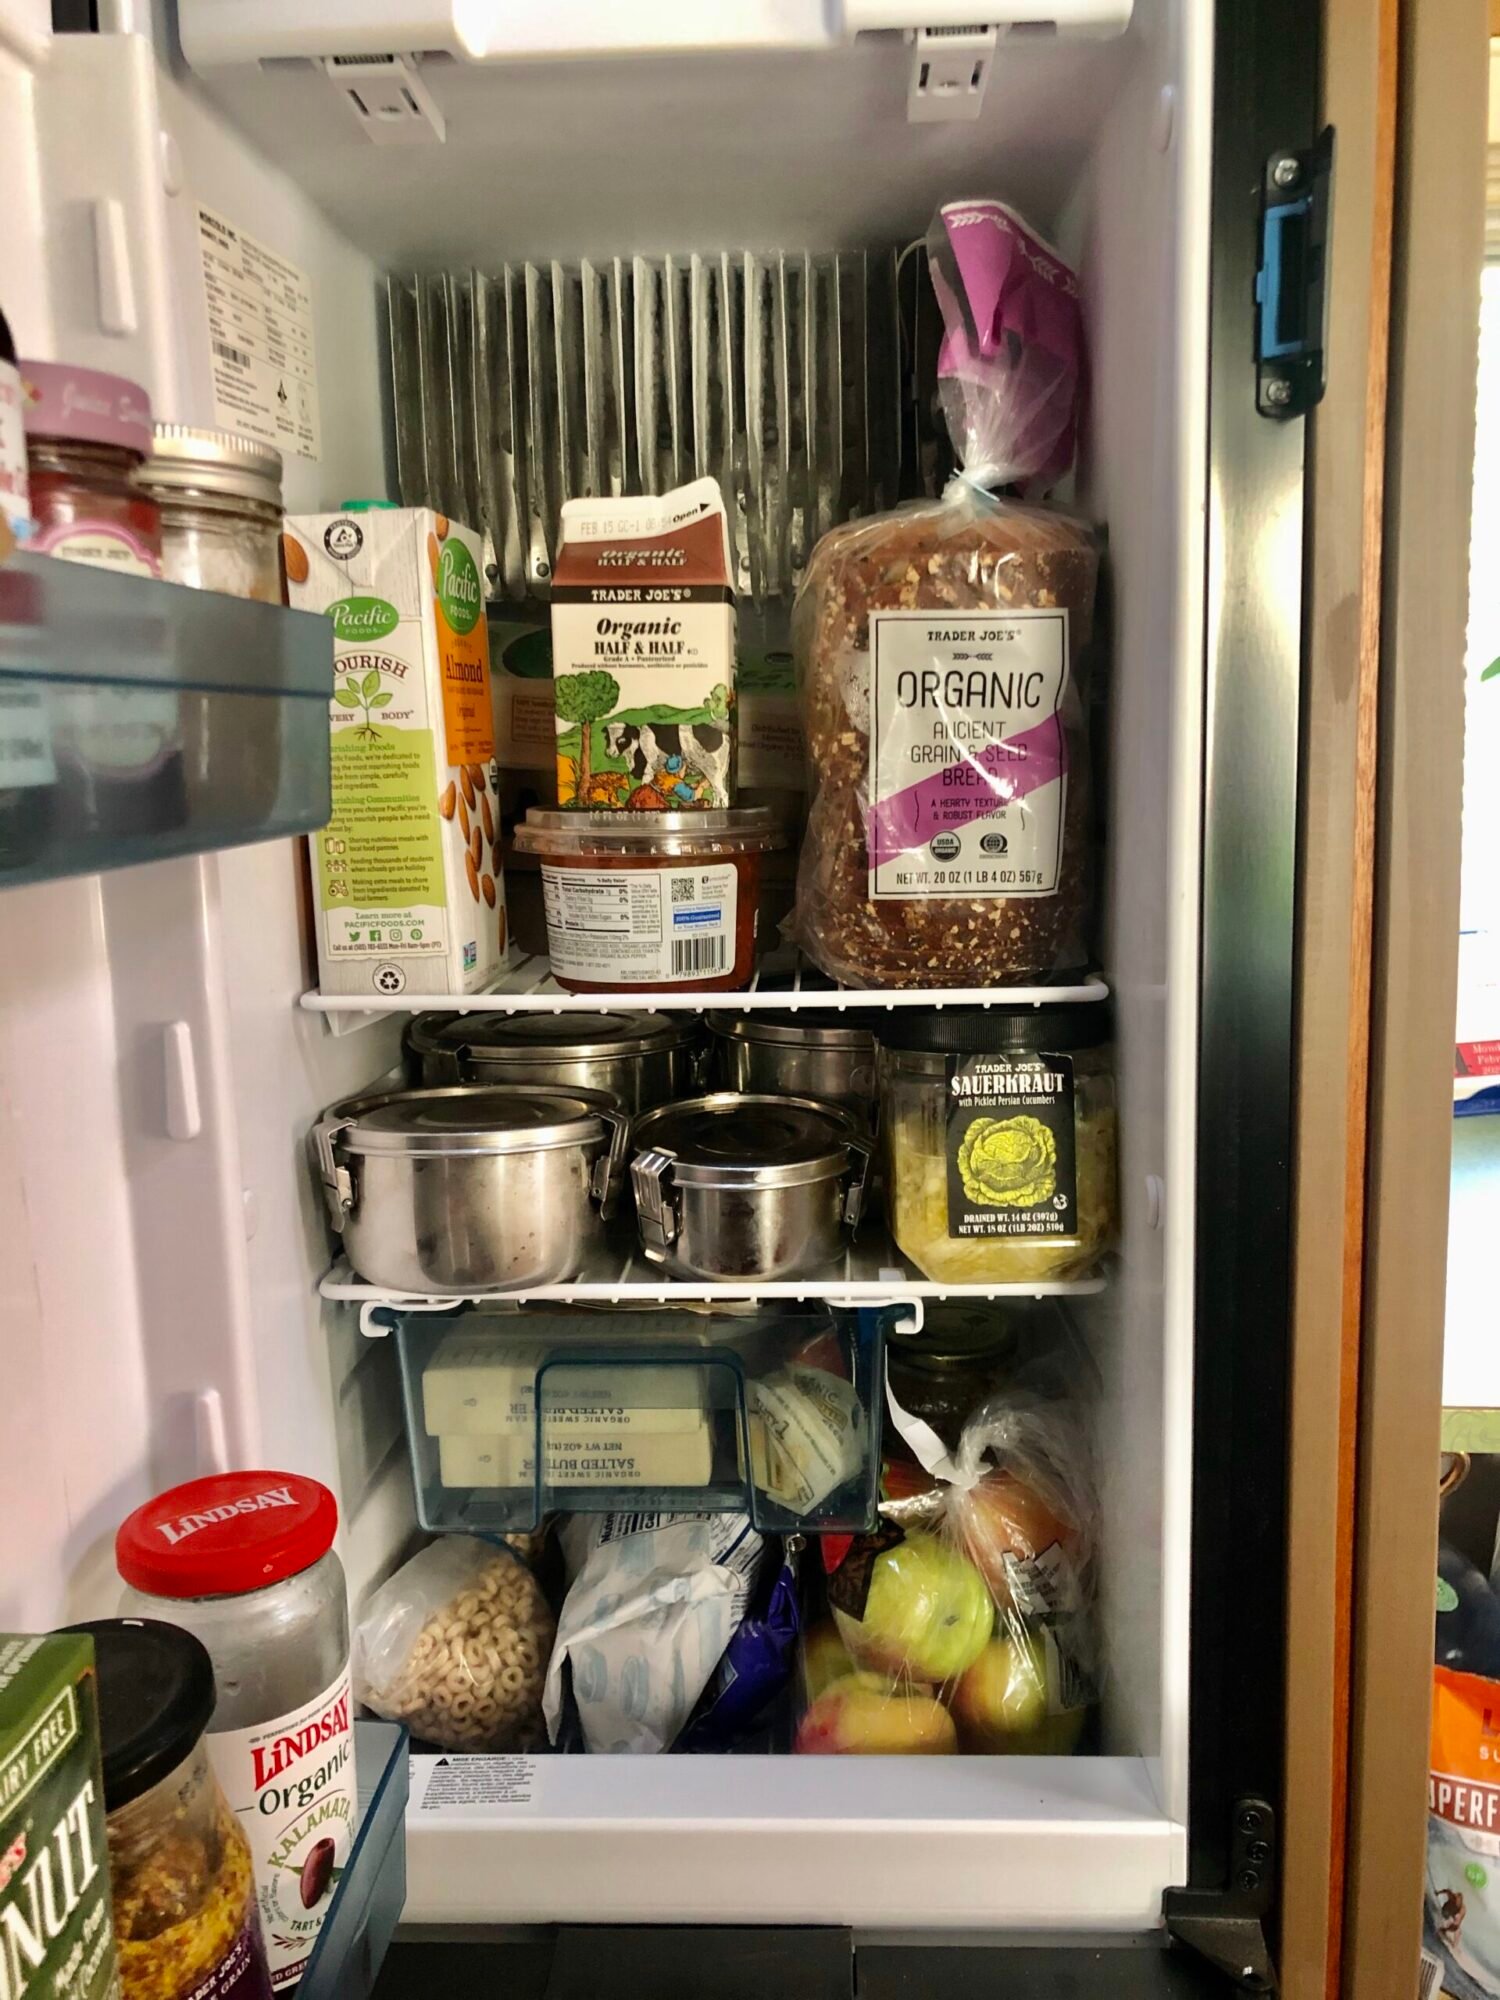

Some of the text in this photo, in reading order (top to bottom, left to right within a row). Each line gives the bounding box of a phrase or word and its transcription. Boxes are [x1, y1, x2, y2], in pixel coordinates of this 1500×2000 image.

[672, 508, 698, 523] Open
[581, 521, 597, 535] FEB
[603, 519, 613, 534] 15
[602, 548, 685, 561] Organic
[597, 558, 630, 566] HALF
[652, 558, 687, 566] HALF
[442, 549, 478, 604] Pacific
[591, 589, 641, 601] TRADER
[330, 604, 391, 628] Pacific
[596, 617, 682, 640] Organic
[927, 630, 976, 642] TRADER
[594, 641, 685, 655] HALF & HALF
[333, 655, 409, 679] OURISH
[446, 653, 484, 683] Almond
[897, 670, 1044, 709] ORGANIC
[328, 714, 355, 722] VERY
[933, 721, 1006, 740] ANCIENT
[911, 745, 962, 763] GRAIN
[985, 743, 1028, 762] SEED
[930, 799, 937, 807] A
[940, 799, 971, 808] HEARTY
[942, 810, 973, 820] ROBUST
[976, 809, 1007, 820] FLAVOR
[896, 873, 914, 884] NET
[934, 871, 946, 884] 20
[948, 871, 961, 884] OZ
[963, 870, 972, 885] (1
[976, 870, 988, 883] LB
[991, 871, 997, 883] 4
[1000, 870, 1016, 884] OZ)
[1019, 870, 1043, 885] 567g
[572, 887, 604, 895] Carbohydrate
[344, 919, 425, 929] PACIFICFOODS.COM
[975, 1064, 1012, 1074] TRADER
[951, 1073, 1064, 1096] SAUERKRAUT
[959, 1096, 1055, 1107] with Pickled Persian Cucumbers
[964, 1213, 996, 1223] DRAINED
[997, 1213, 1010, 1222] WT.
[1011, 1213, 1020, 1222] 14
[1022, 1213, 1031, 1222] OZ
[958, 1225, 972, 1234] NET
[973, 1225, 987, 1233] WT.
[1000, 1224, 1007, 1233] OZ
[584, 1415, 631, 1424] ORGANIC
[584, 1442, 601, 1451] WT
[603, 1442, 623, 1451] NET
[522, 1458, 635, 1470] SALTED BUTR
[595, 1471, 641, 1479] ORGANIC
[33, 1711, 66, 1765] FREE
[259, 1738, 351, 1816] Organic
[267, 1796, 351, 1869] KALAMATA
[0, 1779, 99, 2000] NUT
[290, 1919, 313, 1931] TART
[284, 1960, 308, 1978] GRE
